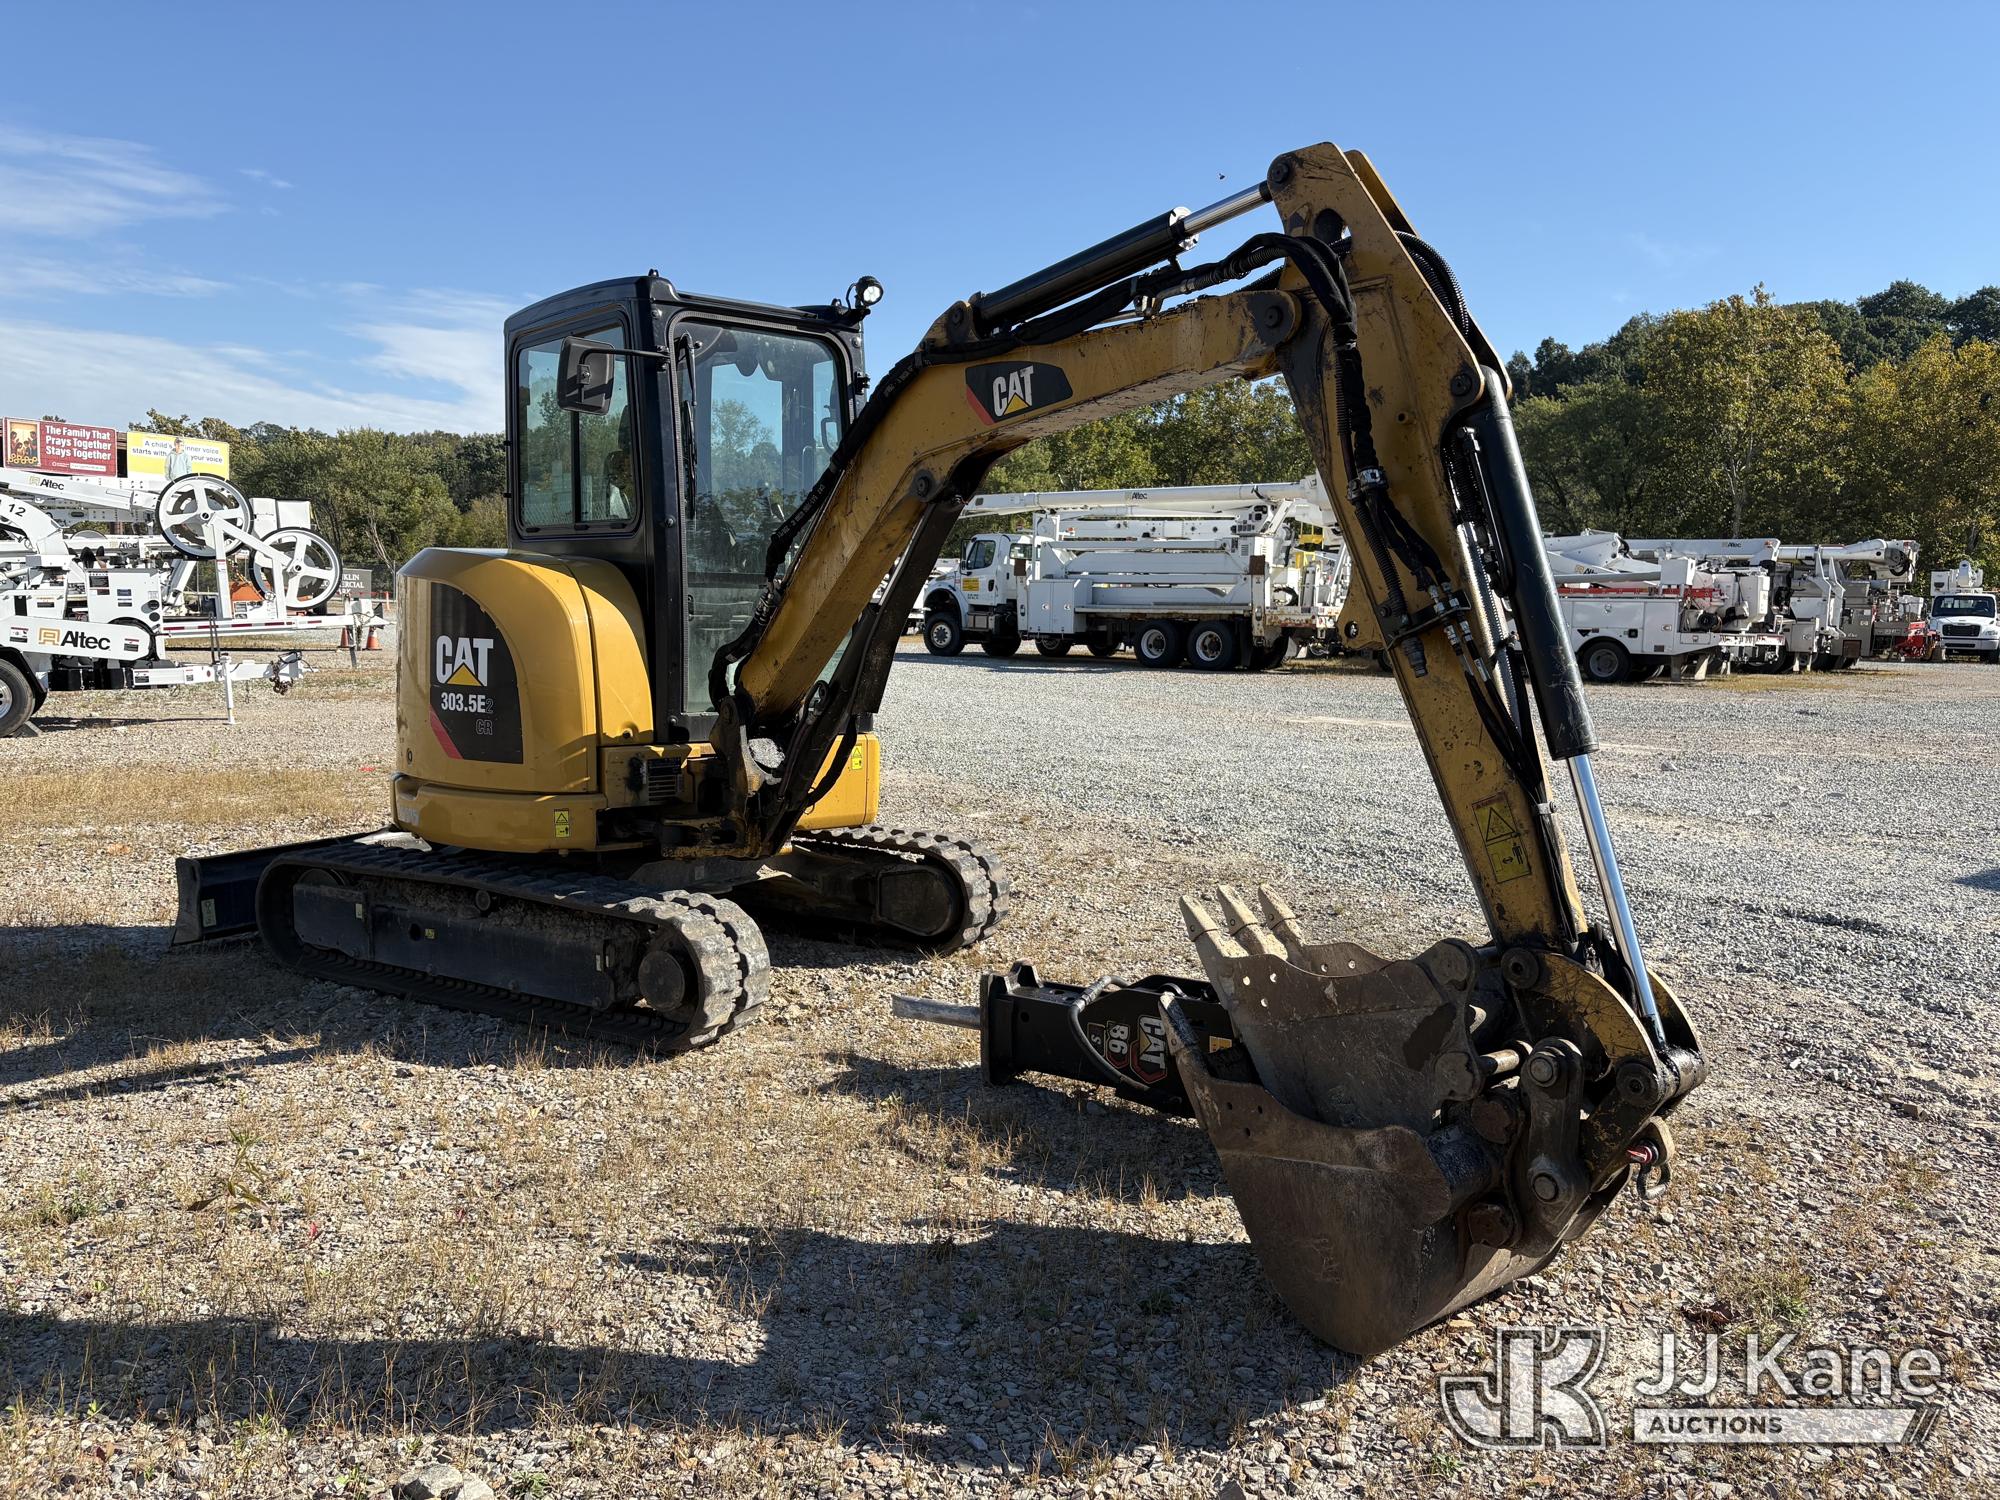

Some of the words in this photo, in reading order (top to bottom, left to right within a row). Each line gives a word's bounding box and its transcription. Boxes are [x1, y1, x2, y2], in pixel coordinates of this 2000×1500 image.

[992, 365, 1034, 417] CAT
[45, 425, 61, 435] The
[63, 427, 91, 439] Family
[92, 430, 111, 440] That
[45, 435, 72, 448] Prays
[73, 438, 112, 450] Together
[45, 446, 72, 458] Stays
[73, 448, 112, 460] Together
[40, 478, 65, 491] Altec
[9, 504, 26, 517] 12
[60, 630, 111, 650] Altec
[436, 635, 494, 687] CAT
[475, 718, 493, 735] CR
[1139, 1016, 1166, 1070] CAT
